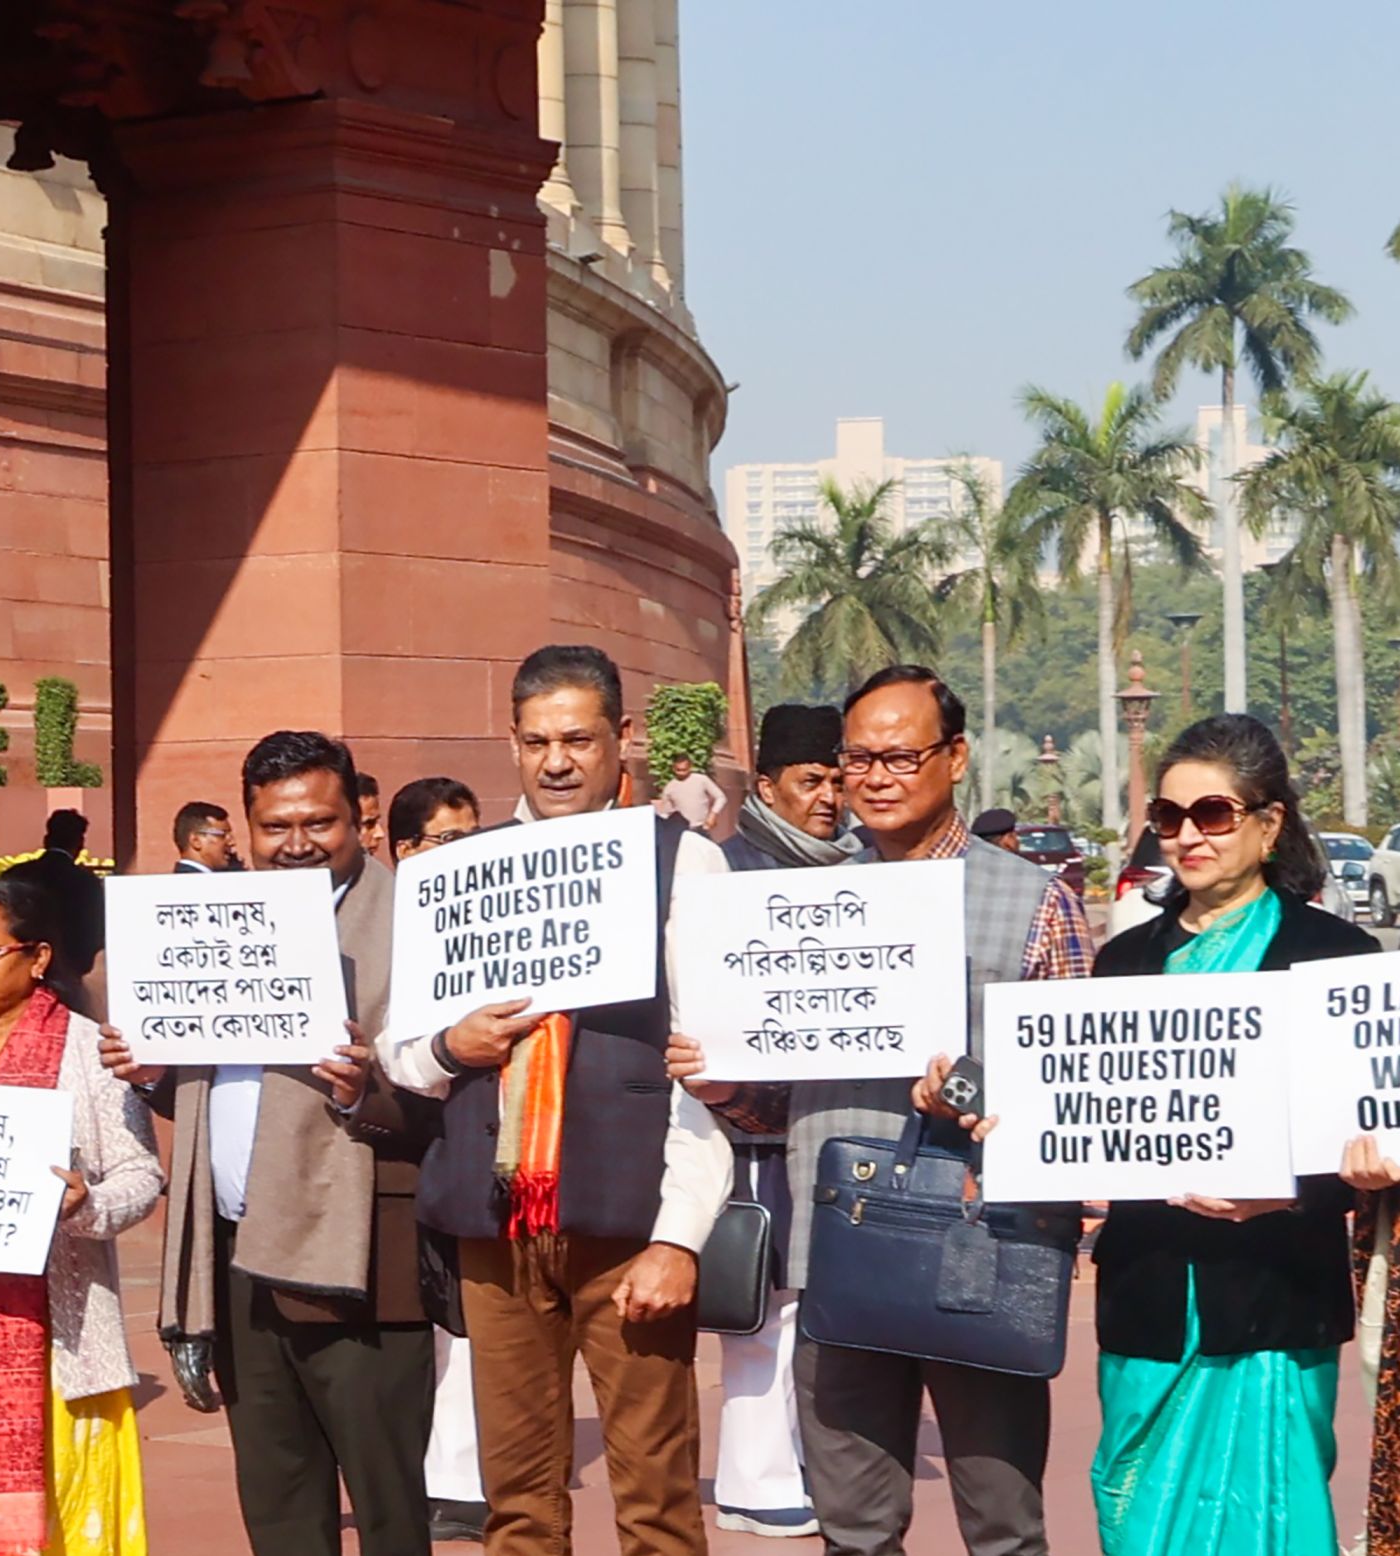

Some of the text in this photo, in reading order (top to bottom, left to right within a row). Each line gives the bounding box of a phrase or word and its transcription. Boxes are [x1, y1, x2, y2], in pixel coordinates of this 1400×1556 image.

[418, 839, 623, 908] 59 LAKH VOICES
[155, 903, 201, 929] লক্ষ
[434, 877, 602, 934] ONE QUESTION
[765, 889, 868, 931] বিজেপি
[158, 939, 277, 970] একটাই প্রশ্ন
[444, 918, 590, 966] Where Are
[132, 979, 228, 1005] আমাদের
[433, 945, 602, 1001] Our Wages?
[764, 986, 878, 1014] বাংলাকে
[1327, 984, 1371, 1018] 59
[141, 1011, 310, 1041] বেতন কোথায়?
[742, 1017, 905, 1054] বঞ্চিত করছে
[1017, 1005, 1262, 1049] 59 LAKH VOICES
[1040, 1047, 1236, 1086] ONE QUESTION
[1054, 1088, 1221, 1126] Where Are
[1039, 1125, 1234, 1167] Our Wages?
